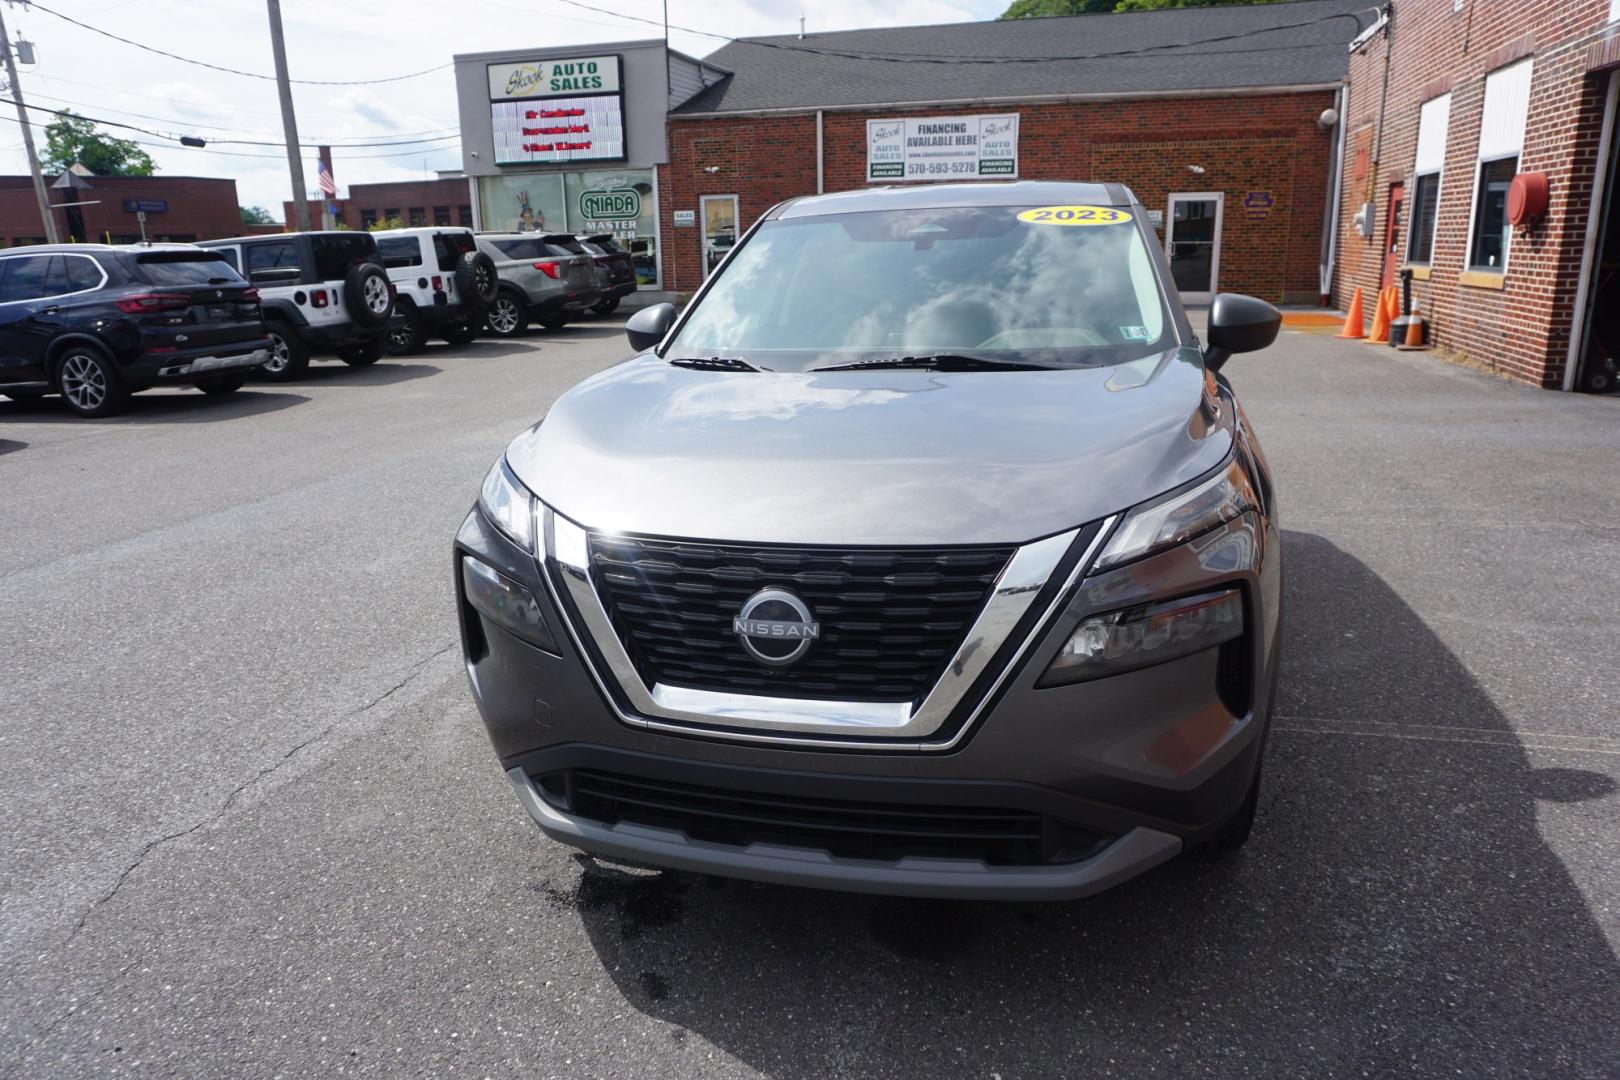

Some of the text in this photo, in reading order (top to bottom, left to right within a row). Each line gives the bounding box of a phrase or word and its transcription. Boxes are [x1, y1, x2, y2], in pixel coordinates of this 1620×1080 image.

[552, 62, 598, 77] AUTO
[550, 76, 602, 92] SALES
[918, 123, 967, 135] FINANCING
[907, 135, 978, 147] AVAILABLE HERE
[873, 152, 901, 160] SALES
[908, 162, 976, 174] 570-593-5278
[585, 195, 634, 213] NIADA
[1033, 210, 1119, 221] 2023
[586, 220, 637, 230] MASTER
[735, 621, 817, 636] NISSAN
